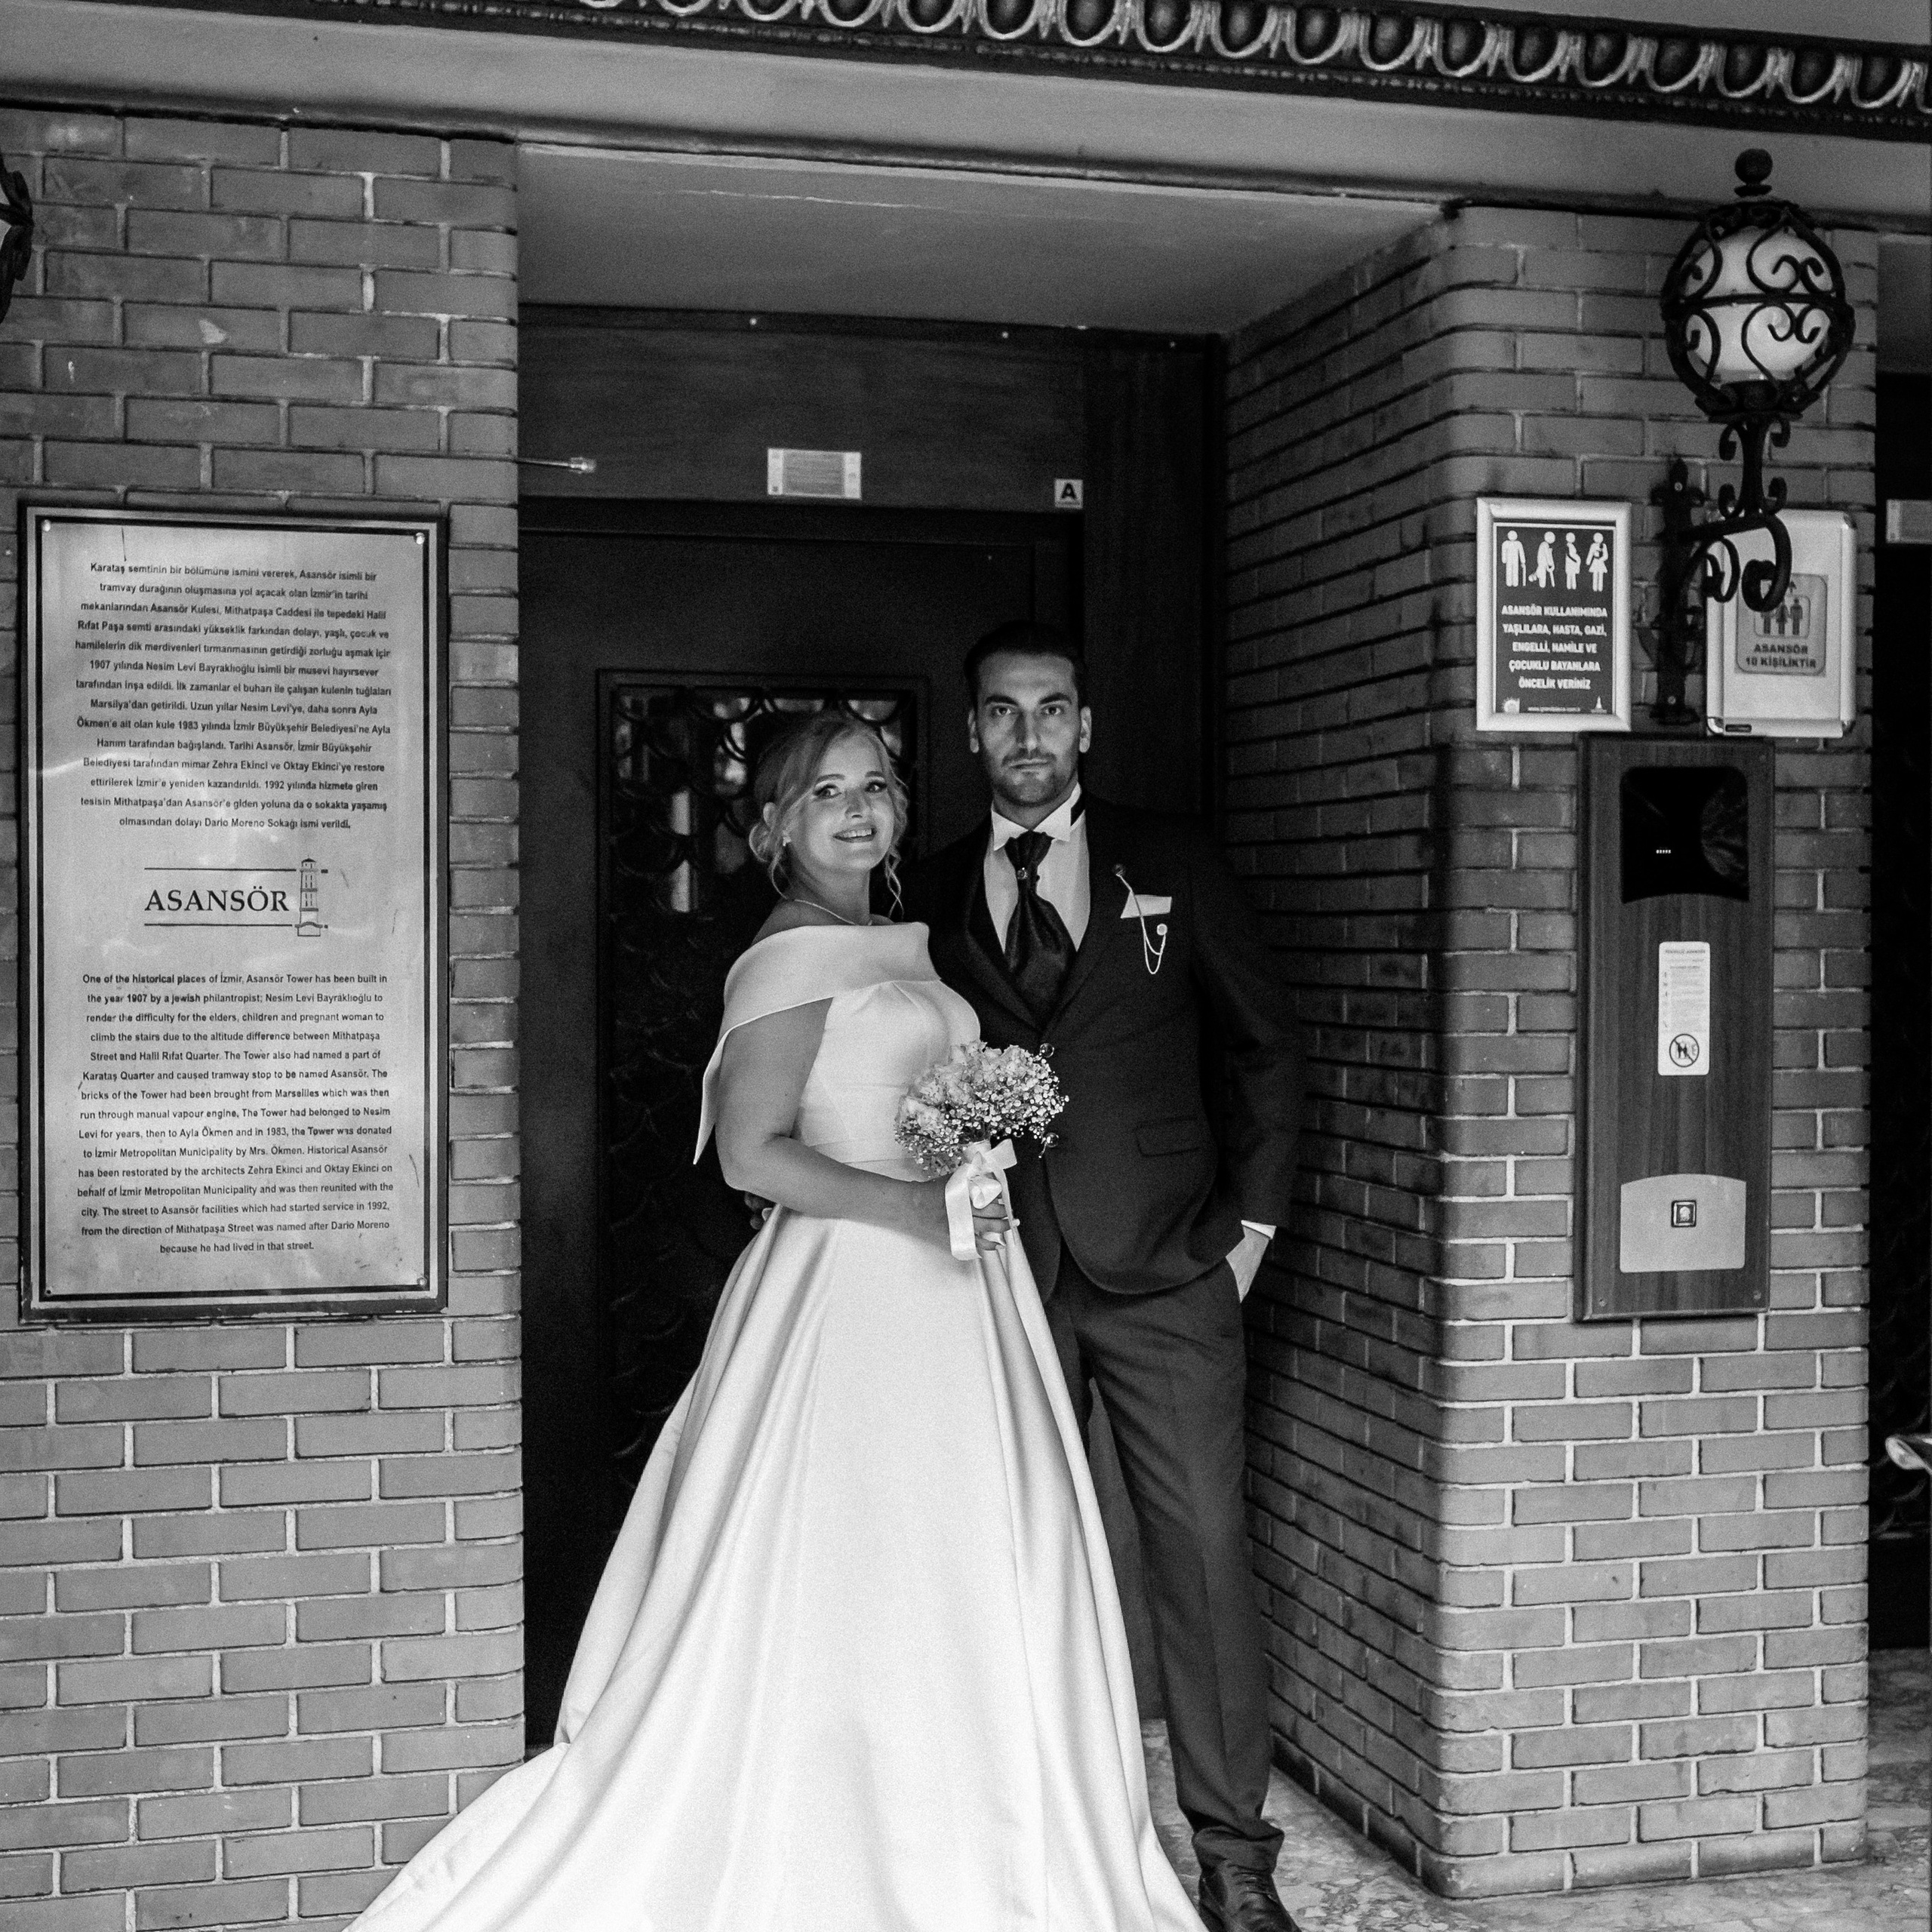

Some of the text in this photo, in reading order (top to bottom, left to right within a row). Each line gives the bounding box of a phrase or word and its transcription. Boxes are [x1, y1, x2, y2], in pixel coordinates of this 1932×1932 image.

[1061, 483, 1076, 499] A
[100, 583, 136, 595] tramvay
[239, 586, 253, 598] yol
[289, 588, 308, 598] olan
[346, 590, 368, 600] tarihi
[1501, 604, 1543, 615] ASANSÖR
[1586, 643, 1597, 654] VE
[190, 701, 213, 711] Uzun
[240, 702, 268, 712] Nesim
[308, 703, 329, 714] daha
[331, 706, 356, 714] sonra
[359, 705, 378, 715] Ayla
[120, 719, 131, 729] ait
[134, 720, 153, 730] olan
[155, 720, 175, 730] kule
[179, 721, 198, 731] 1983
[372, 724, 391, 735] Ayla
[84, 758, 131, 769] Belediyesi
[181, 759, 209, 769] mimar
[212, 760, 238, 770] Zehra
[241, 761, 268, 771] Ekinci
[271, 762, 280, 771] ve
[283, 761, 309, 772] Oktay
[354, 762, 386, 772] restore
[169, 778, 205, 789] yeniden
[265, 780, 285, 789] 1992
[318, 780, 353, 791] hizmete
[355, 781, 379, 792] giren
[205, 817, 228, 827] Dario
[231, 818, 264, 828] Moreno
[300, 819, 318, 828] ismi
[145, 886, 289, 911] ASANSÖR
[83, 974, 101, 983] One
[104, 974, 113, 983] of
[115, 974, 130, 983] the
[132, 974, 174, 983] historical
[177, 974, 206, 985] places
[209, 974, 218, 983] of
[287, 974, 312, 983] Tower
[315, 974, 331, 983] has
[334, 974, 355, 983] been
[357, 974, 377, 983] built
[379, 974, 387, 983] in
[91, 1051, 117, 1061] Street
[119, 1051, 137, 1061] and
[225, 1051, 241, 1060] The
[244, 1051, 269, 1060] Tower
[273, 1051, 291, 1060] also
[294, 1051, 310, 1060] had
[312, 1050, 342, 1060] named
[345, 1051, 349, 1060] a
[352, 1050, 370, 1060] part
[372, 1050, 381, 1060] of
[82, 1091, 109, 1100] bricks
[112, 1090, 121, 1100] of
[123, 1090, 137, 1100] the
[141, 1090, 167, 1100] Tower
[170, 1090, 187, 1099] had
[189, 1089, 211, 1099] been
[214, 1089, 249, 1100] brought
[251, 1089, 272, 1098] from
[275, 1088, 319, 1098] Marseilles
[322, 1088, 347, 1098] which
[370, 1088, 389, 1097] then
[84, 1149, 92, 1158] to
[120, 1148, 177, 1159] Metropolitan
[179, 1146, 232, 1158] Municipality
[235, 1146, 246, 1157] by
[307, 1145, 349, 1155] Historical
[78, 1187, 106, 1197] behalf
[108, 1187, 117, 1197] of
[144, 1186, 201, 1197] Metropolitan
[203, 1185, 257, 1196] Municipality
[260, 1184, 276, 1194] and
[279, 1186, 296, 1194] was
[299, 1183, 318, 1193] then
[321, 1183, 357, 1193] reunited
[359, 1183, 377, 1192] with
[380, 1182, 394, 1192] the
[103, 1206, 119, 1216] The
[122, 1206, 148, 1216] street
[150, 1205, 159, 1215] to
[202, 1204, 238, 1214] facilities
[242, 1204, 268, 1214] which
[270, 1203, 287, 1213] had
[290, 1203, 320, 1213] started
[323, 1202, 354, 1212] service
[356, 1201, 365, 1211] in
[82, 1226, 103, 1235] from
[105, 1226, 119, 1235] the
[122, 1225, 162, 1235] direction
[165, 1224, 174, 1234] of
[228, 1223, 254, 1233] Street
[257, 1224, 273, 1232] was
[277, 1222, 306, 1232] named
[309, 1221, 328, 1231] after
[331, 1221, 355, 1231] Dario
[357, 1220, 390, 1230] Moreno
